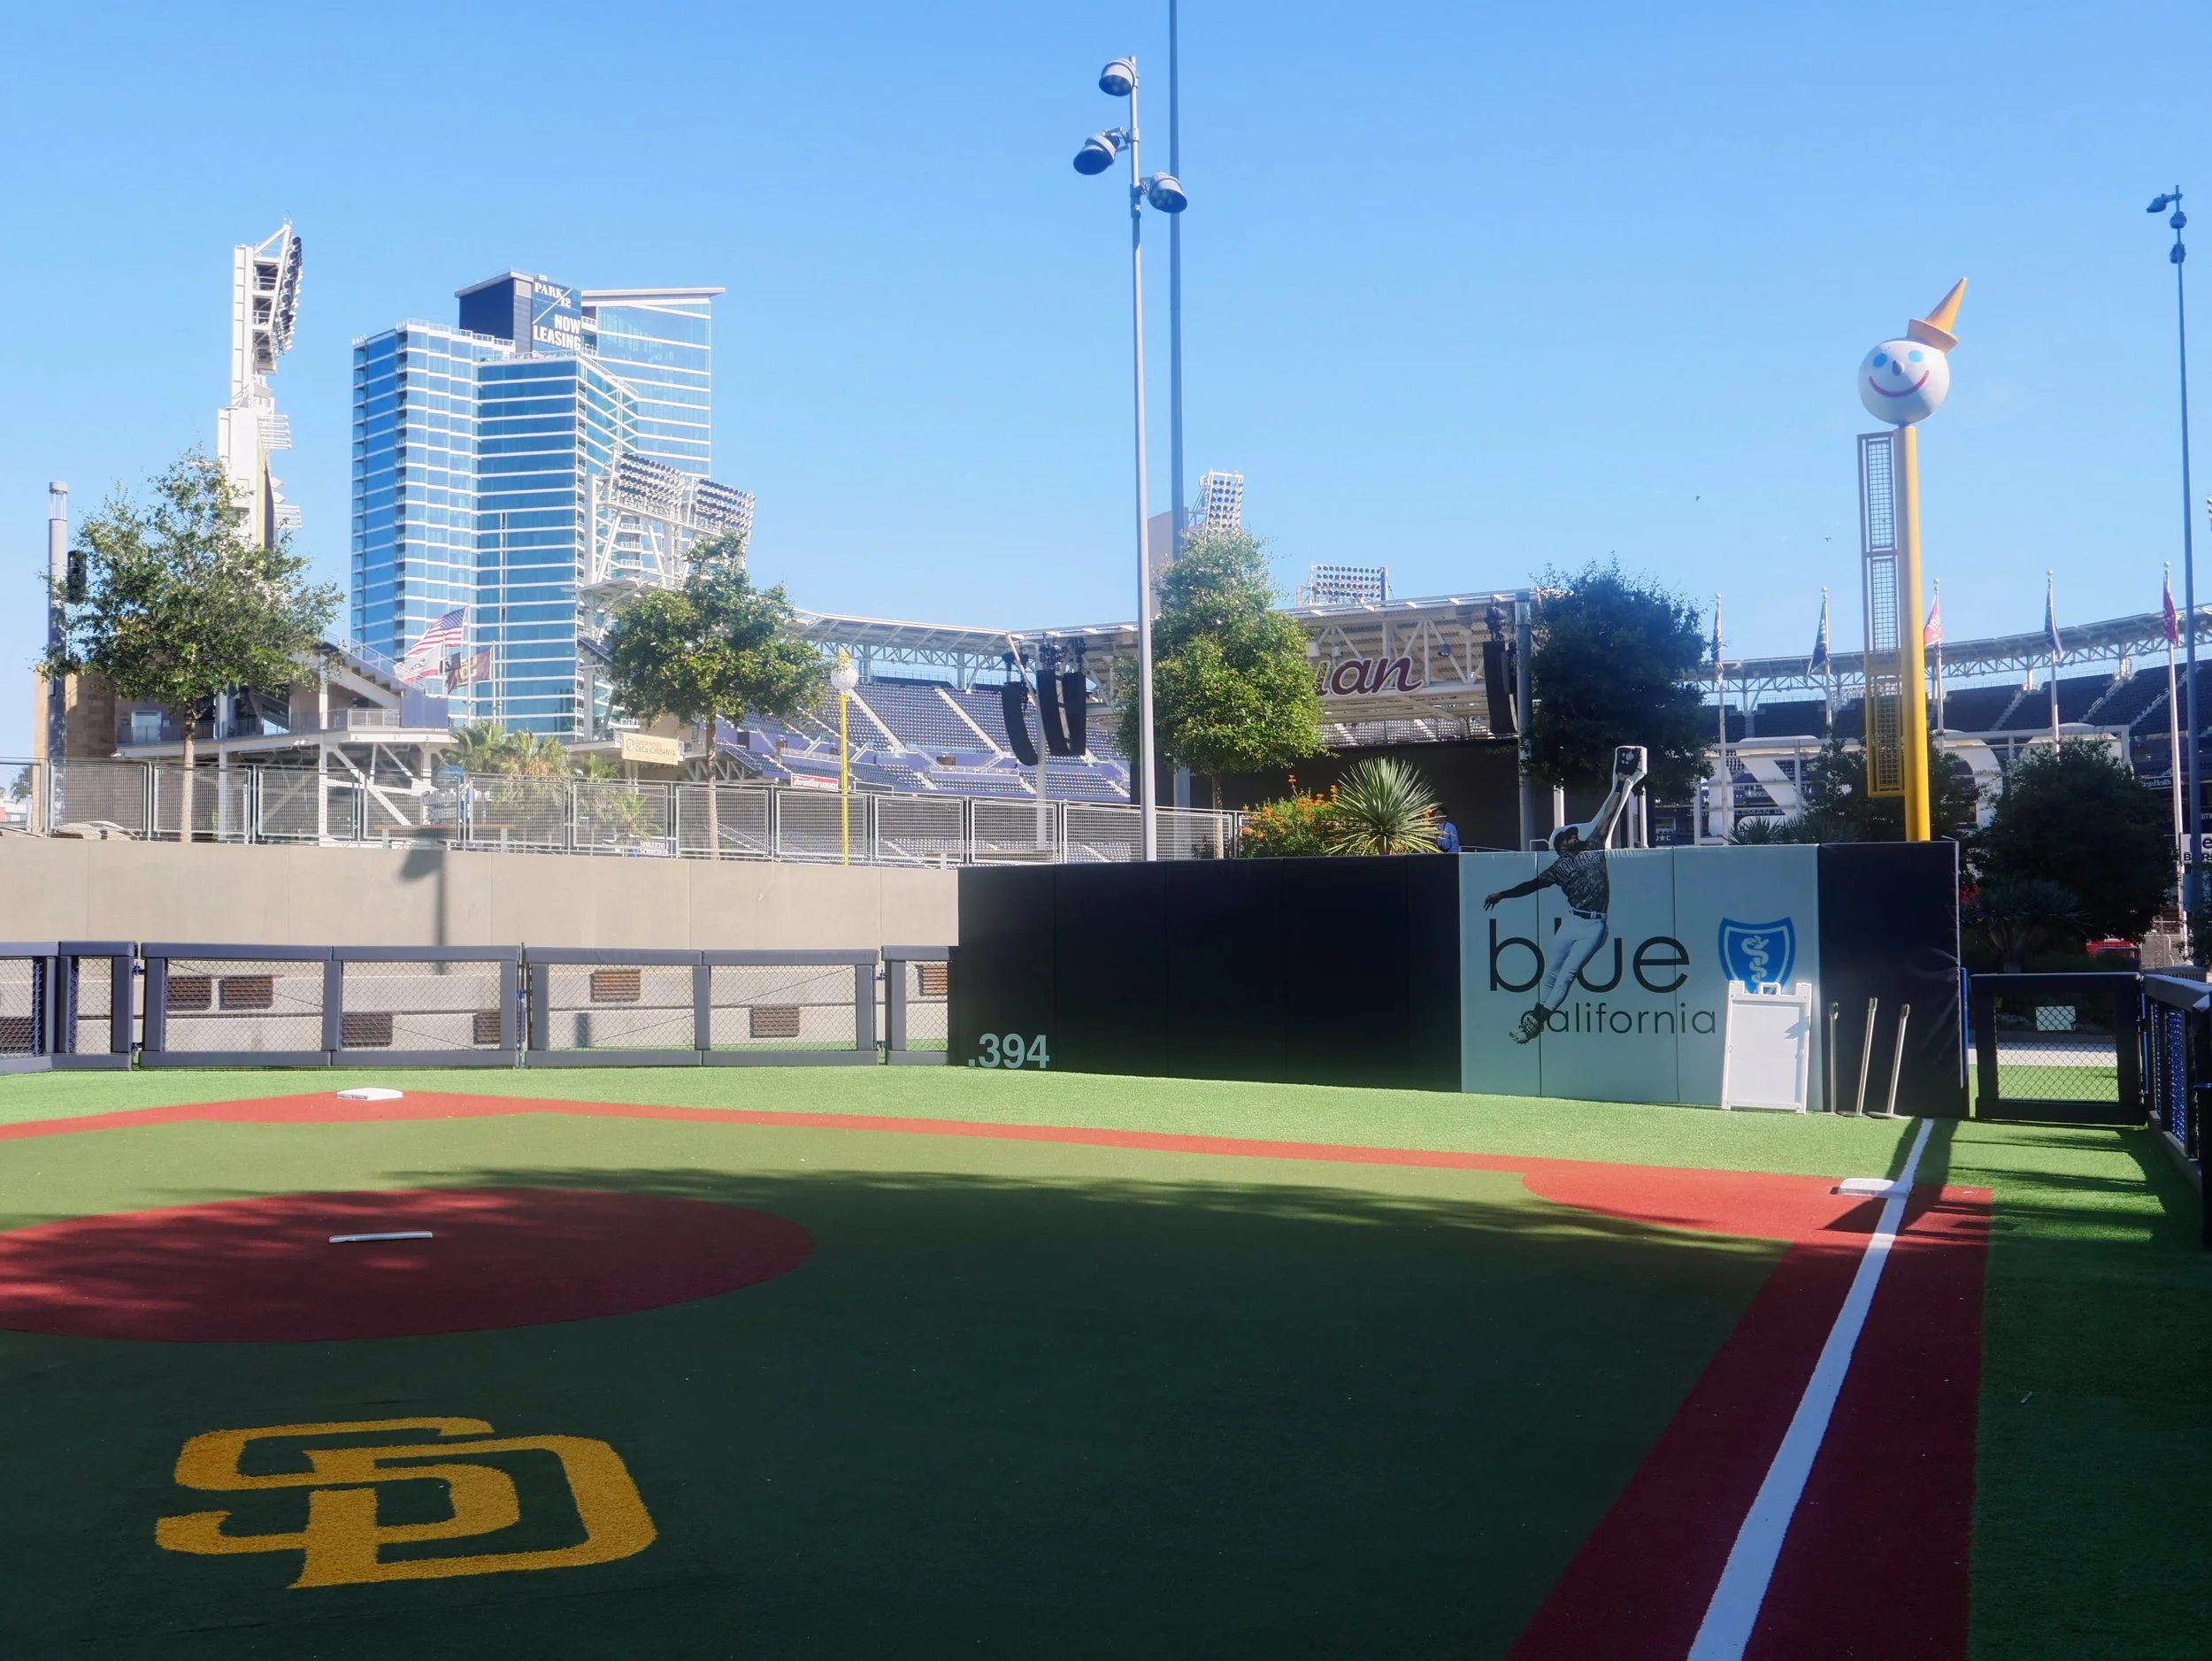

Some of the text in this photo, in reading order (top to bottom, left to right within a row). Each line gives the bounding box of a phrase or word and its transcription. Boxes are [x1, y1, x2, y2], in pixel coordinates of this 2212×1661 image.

[534, 281, 565, 299] PARK
[534, 325, 581, 351] LEASING
[555, 314, 580, 335] NOW
[1489, 918, 1690, 993] bue
[968, 1033, 1050, 1069] .394
[155, 1416, 658, 1589] SD
